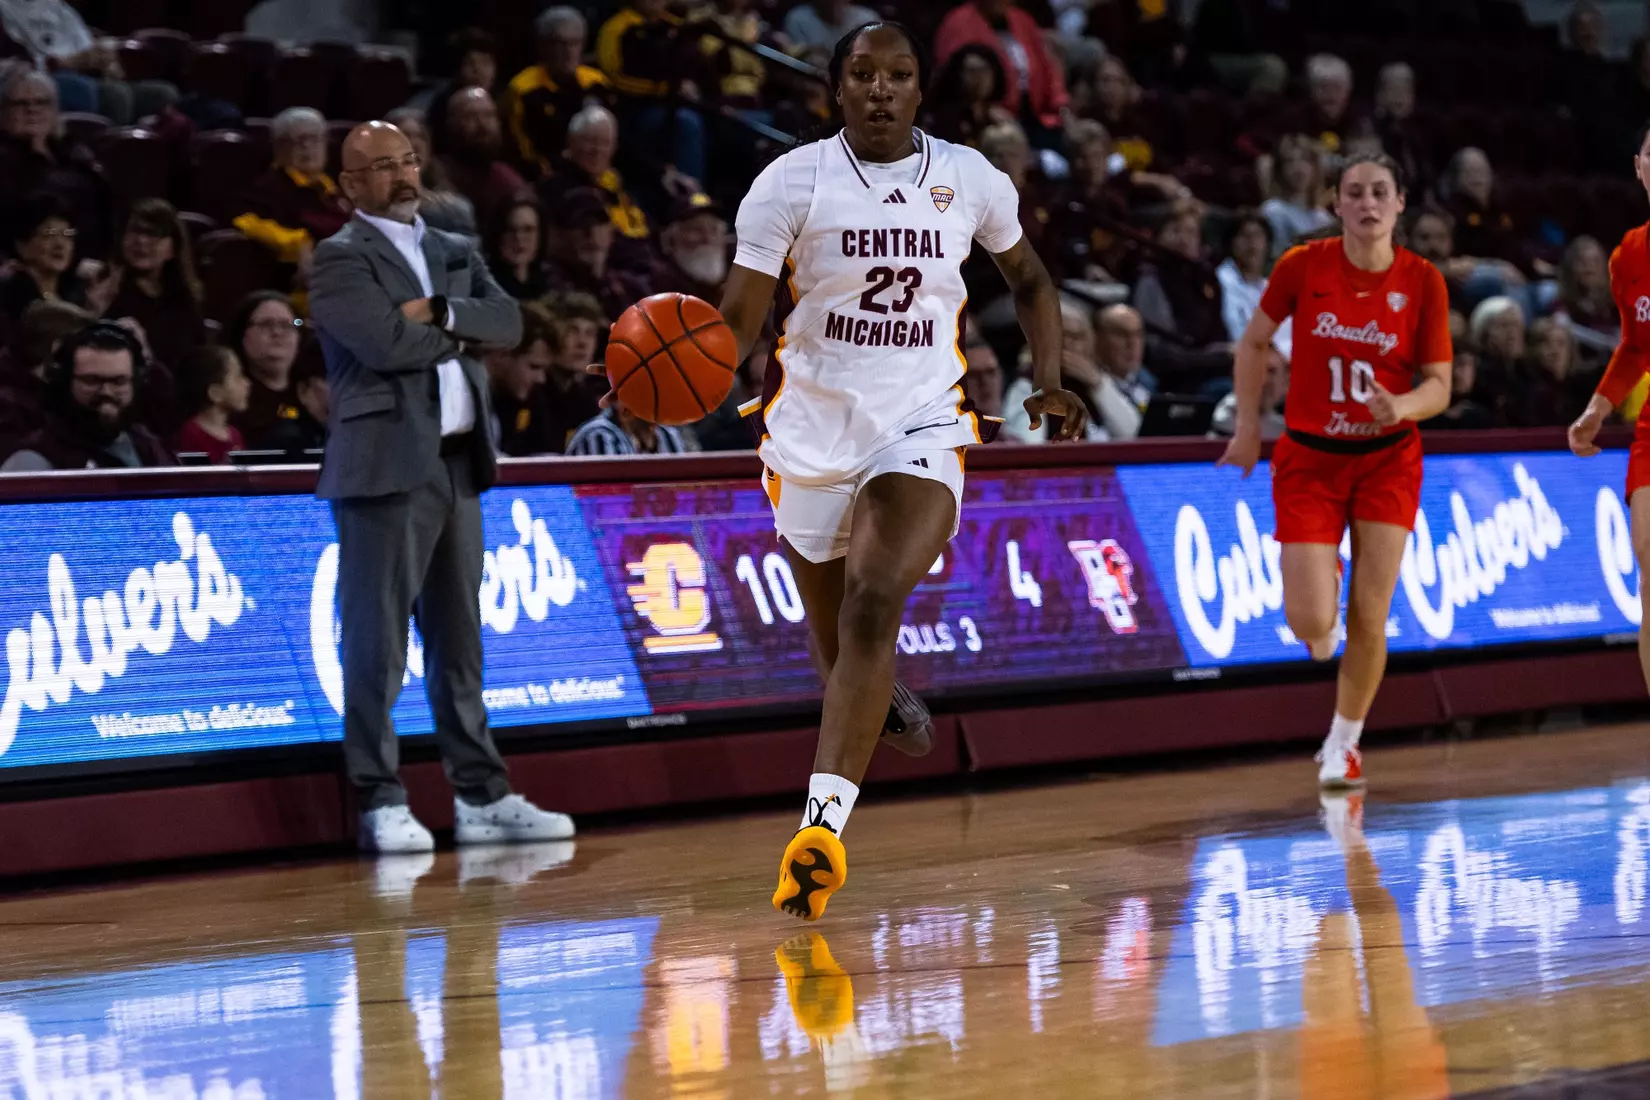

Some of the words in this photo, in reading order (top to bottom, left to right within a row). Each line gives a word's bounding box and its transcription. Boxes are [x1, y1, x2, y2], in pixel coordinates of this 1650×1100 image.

[932, 193, 954, 203] MAC
[842, 228, 944, 258] CENTRAL
[859, 266, 922, 314] 23
[825, 312, 934, 347] MICHIGAN
[1312, 312, 1399, 356] Bowling
[1328, 356, 1375, 404] 10
[1400, 462, 1564, 639] Culver's
[736, 552, 805, 625] 10
[1006, 540, 1043, 608] 4
[0, 512, 245, 757] ulver's
[896, 623, 956, 655] OULS
[959, 615, 982, 652] 3
[481, 686, 530, 709] come
[527, 683, 549, 706] to
[90, 711, 186, 738] Welcome
[183, 709, 209, 731] to
